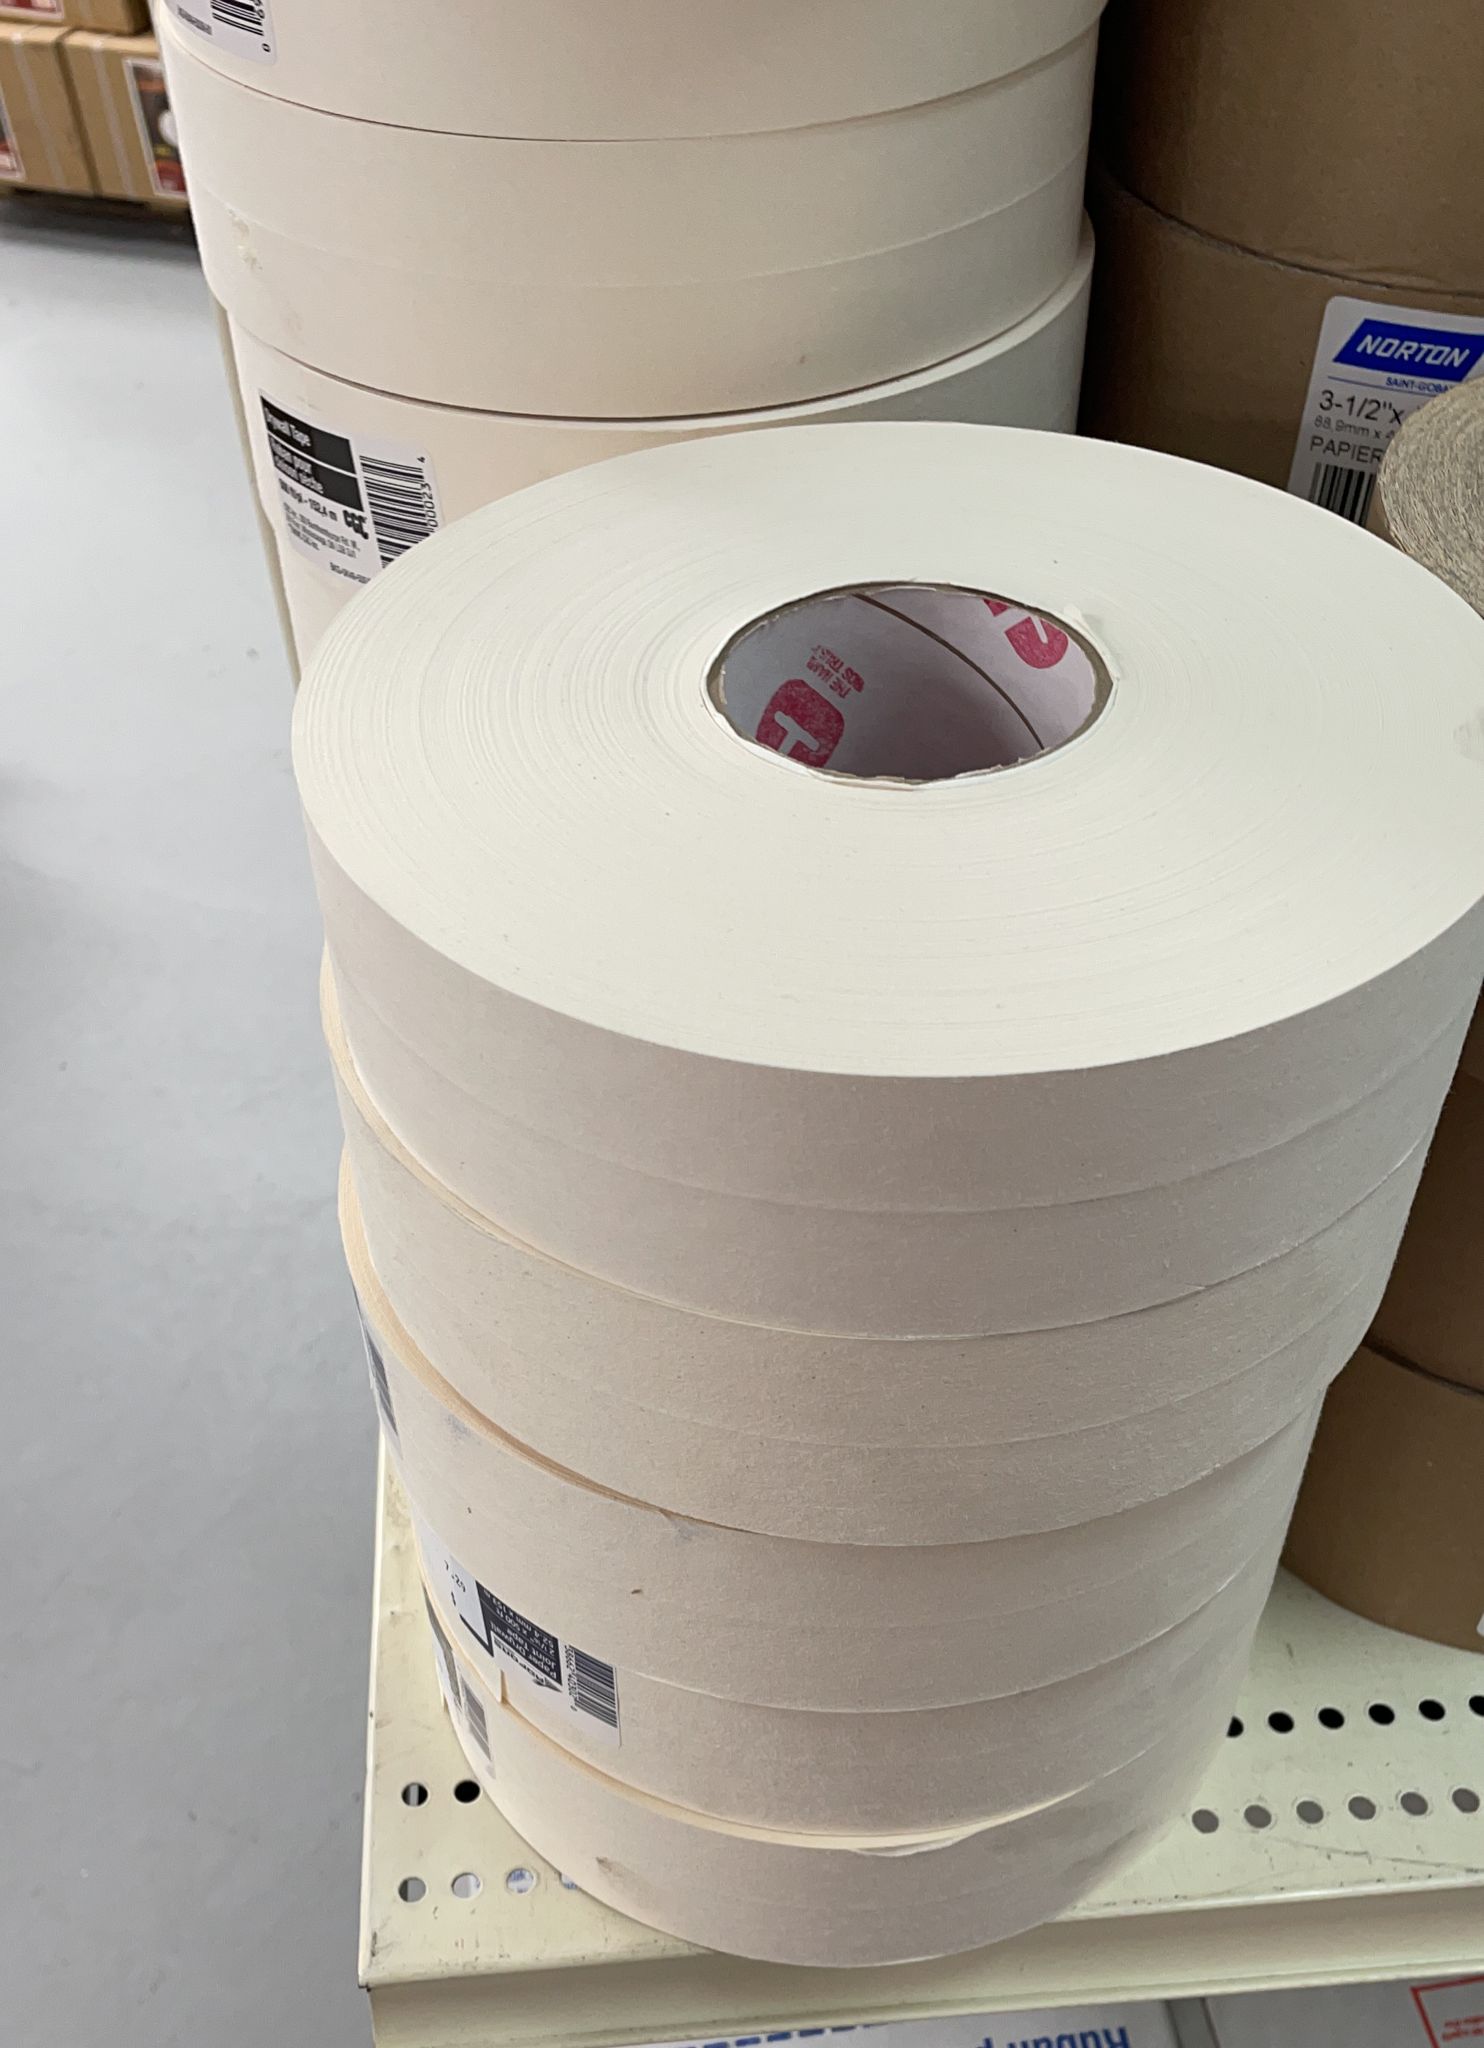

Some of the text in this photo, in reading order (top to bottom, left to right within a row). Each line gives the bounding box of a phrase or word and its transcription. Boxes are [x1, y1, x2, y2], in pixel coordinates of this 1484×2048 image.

[1356, 334, 1471, 368] NORTON
[1385, 377, 1453, 394] SAINT-GOBA
[1309, 435, 1385, 463] PAPIER
[490, 1621, 557, 1679] Paper Drywall
[506, 1627, 557, 1669] Joint Tape
